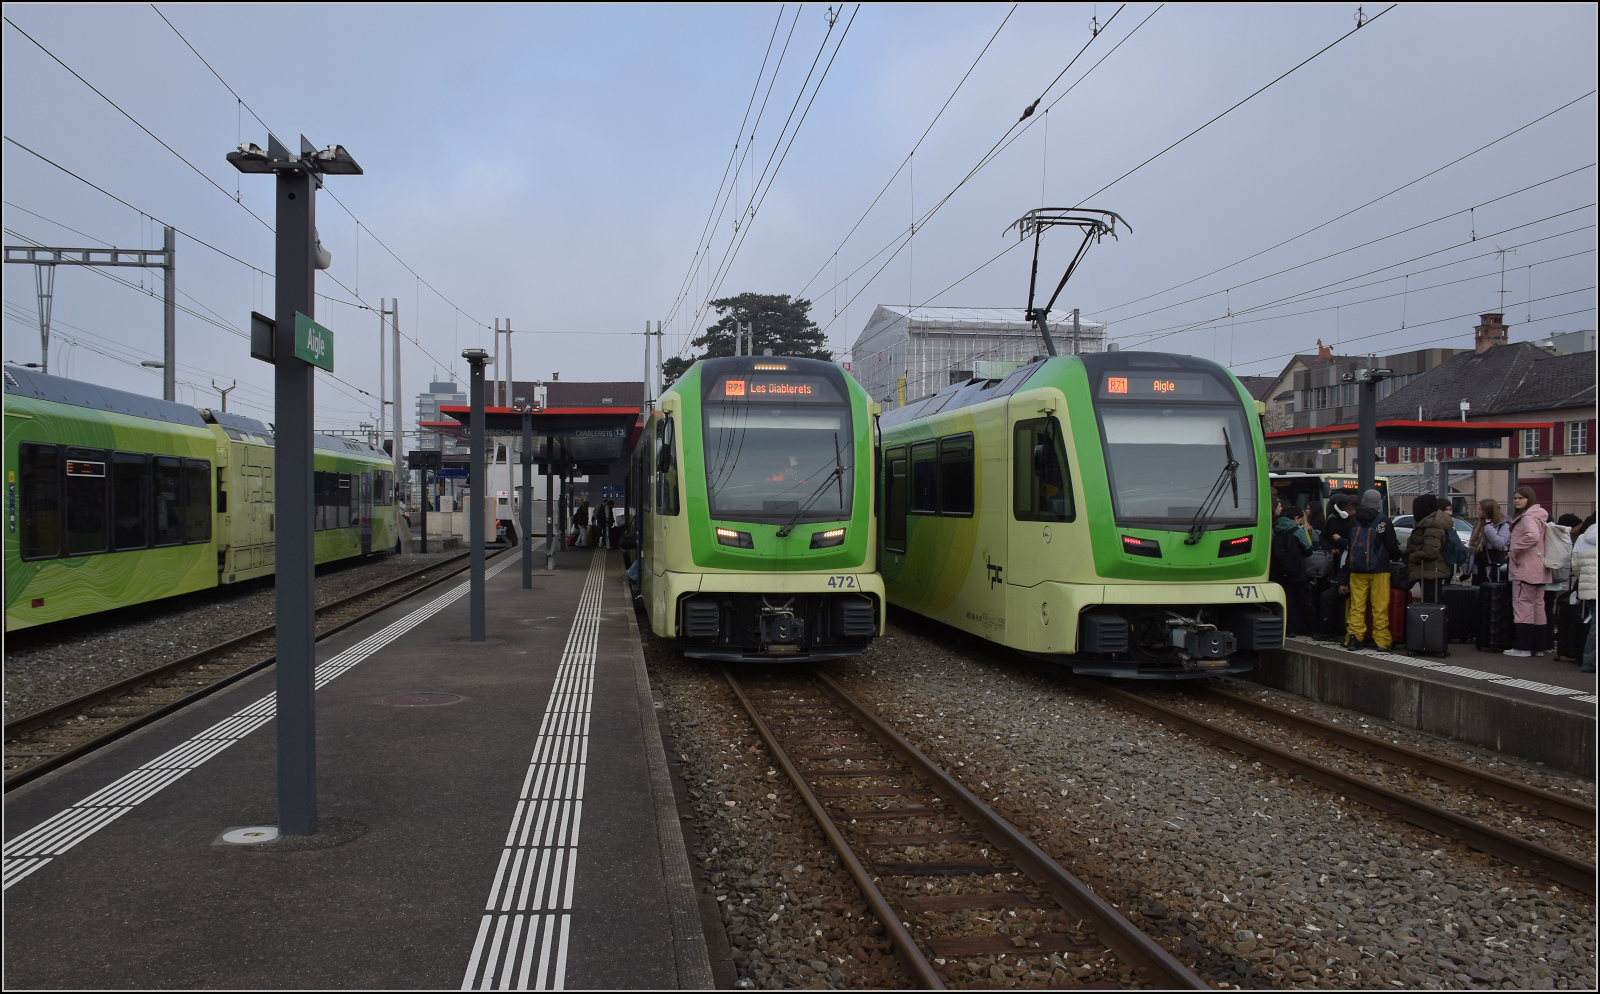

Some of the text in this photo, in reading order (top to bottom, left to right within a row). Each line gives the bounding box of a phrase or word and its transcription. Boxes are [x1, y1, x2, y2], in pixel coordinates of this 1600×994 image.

[307, 328, 325, 359] Aigle
[727, 382, 812, 394] R71 Les Diablerets
[1110, 379, 1175, 393] R71 Aigle
[615, 428, 625, 436] 13
[827, 575, 855, 589] 472
[1235, 585, 1259, 599] 471
